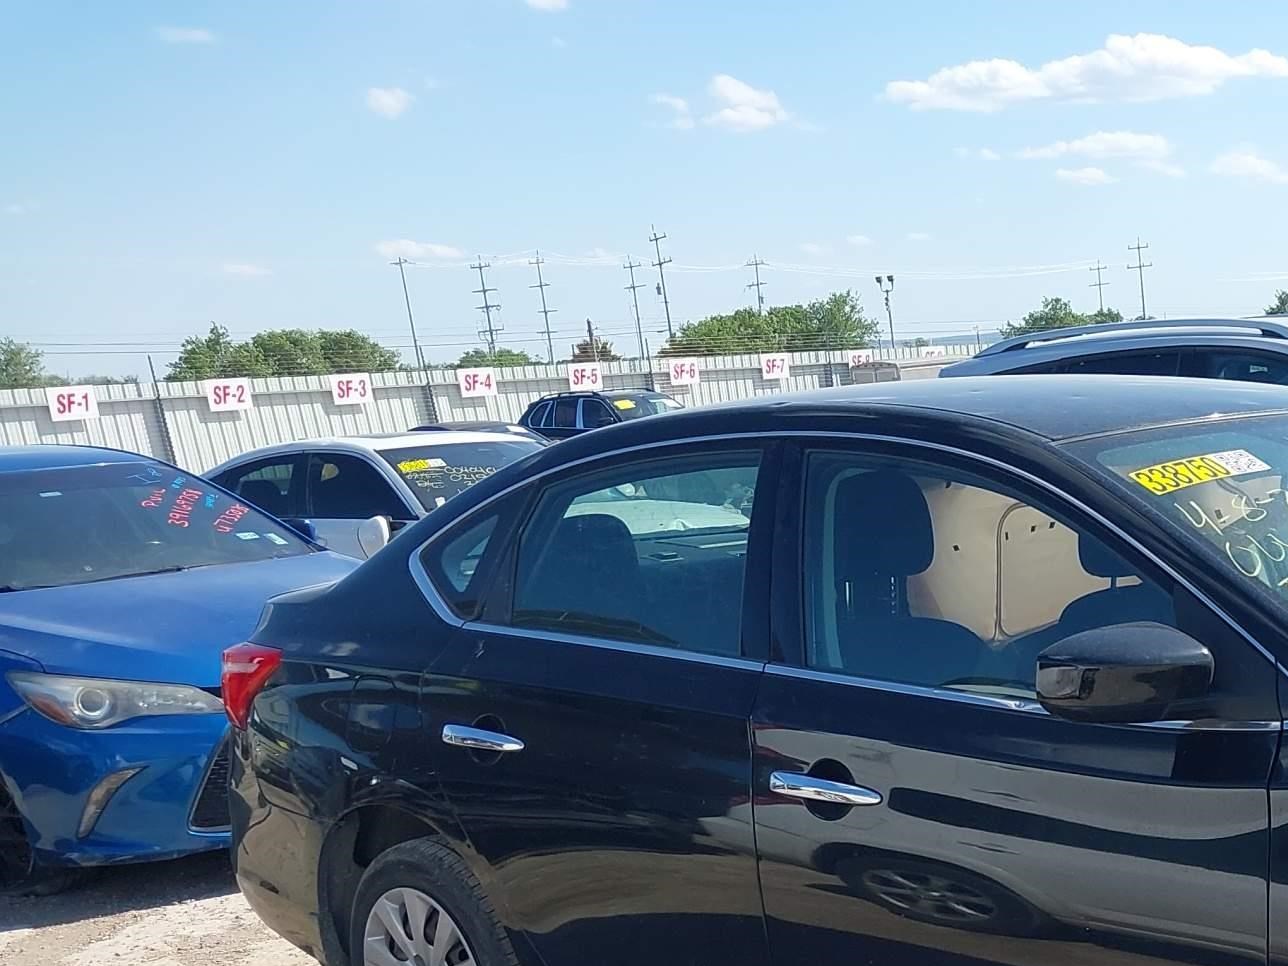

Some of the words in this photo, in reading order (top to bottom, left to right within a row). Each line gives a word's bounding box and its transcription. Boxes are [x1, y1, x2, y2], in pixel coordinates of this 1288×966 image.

[673, 363, 695, 380] SF-6
[765, 358, 785, 374] SF-7
[464, 373, 492, 392] SF-4
[573, 368, 598, 386] SF-5
[213, 385, 245, 405] SF-2
[337, 379, 366, 398] SF-3
[57, 392, 89, 414] SF-1
[1134, 456, 1230, 492] 338750
